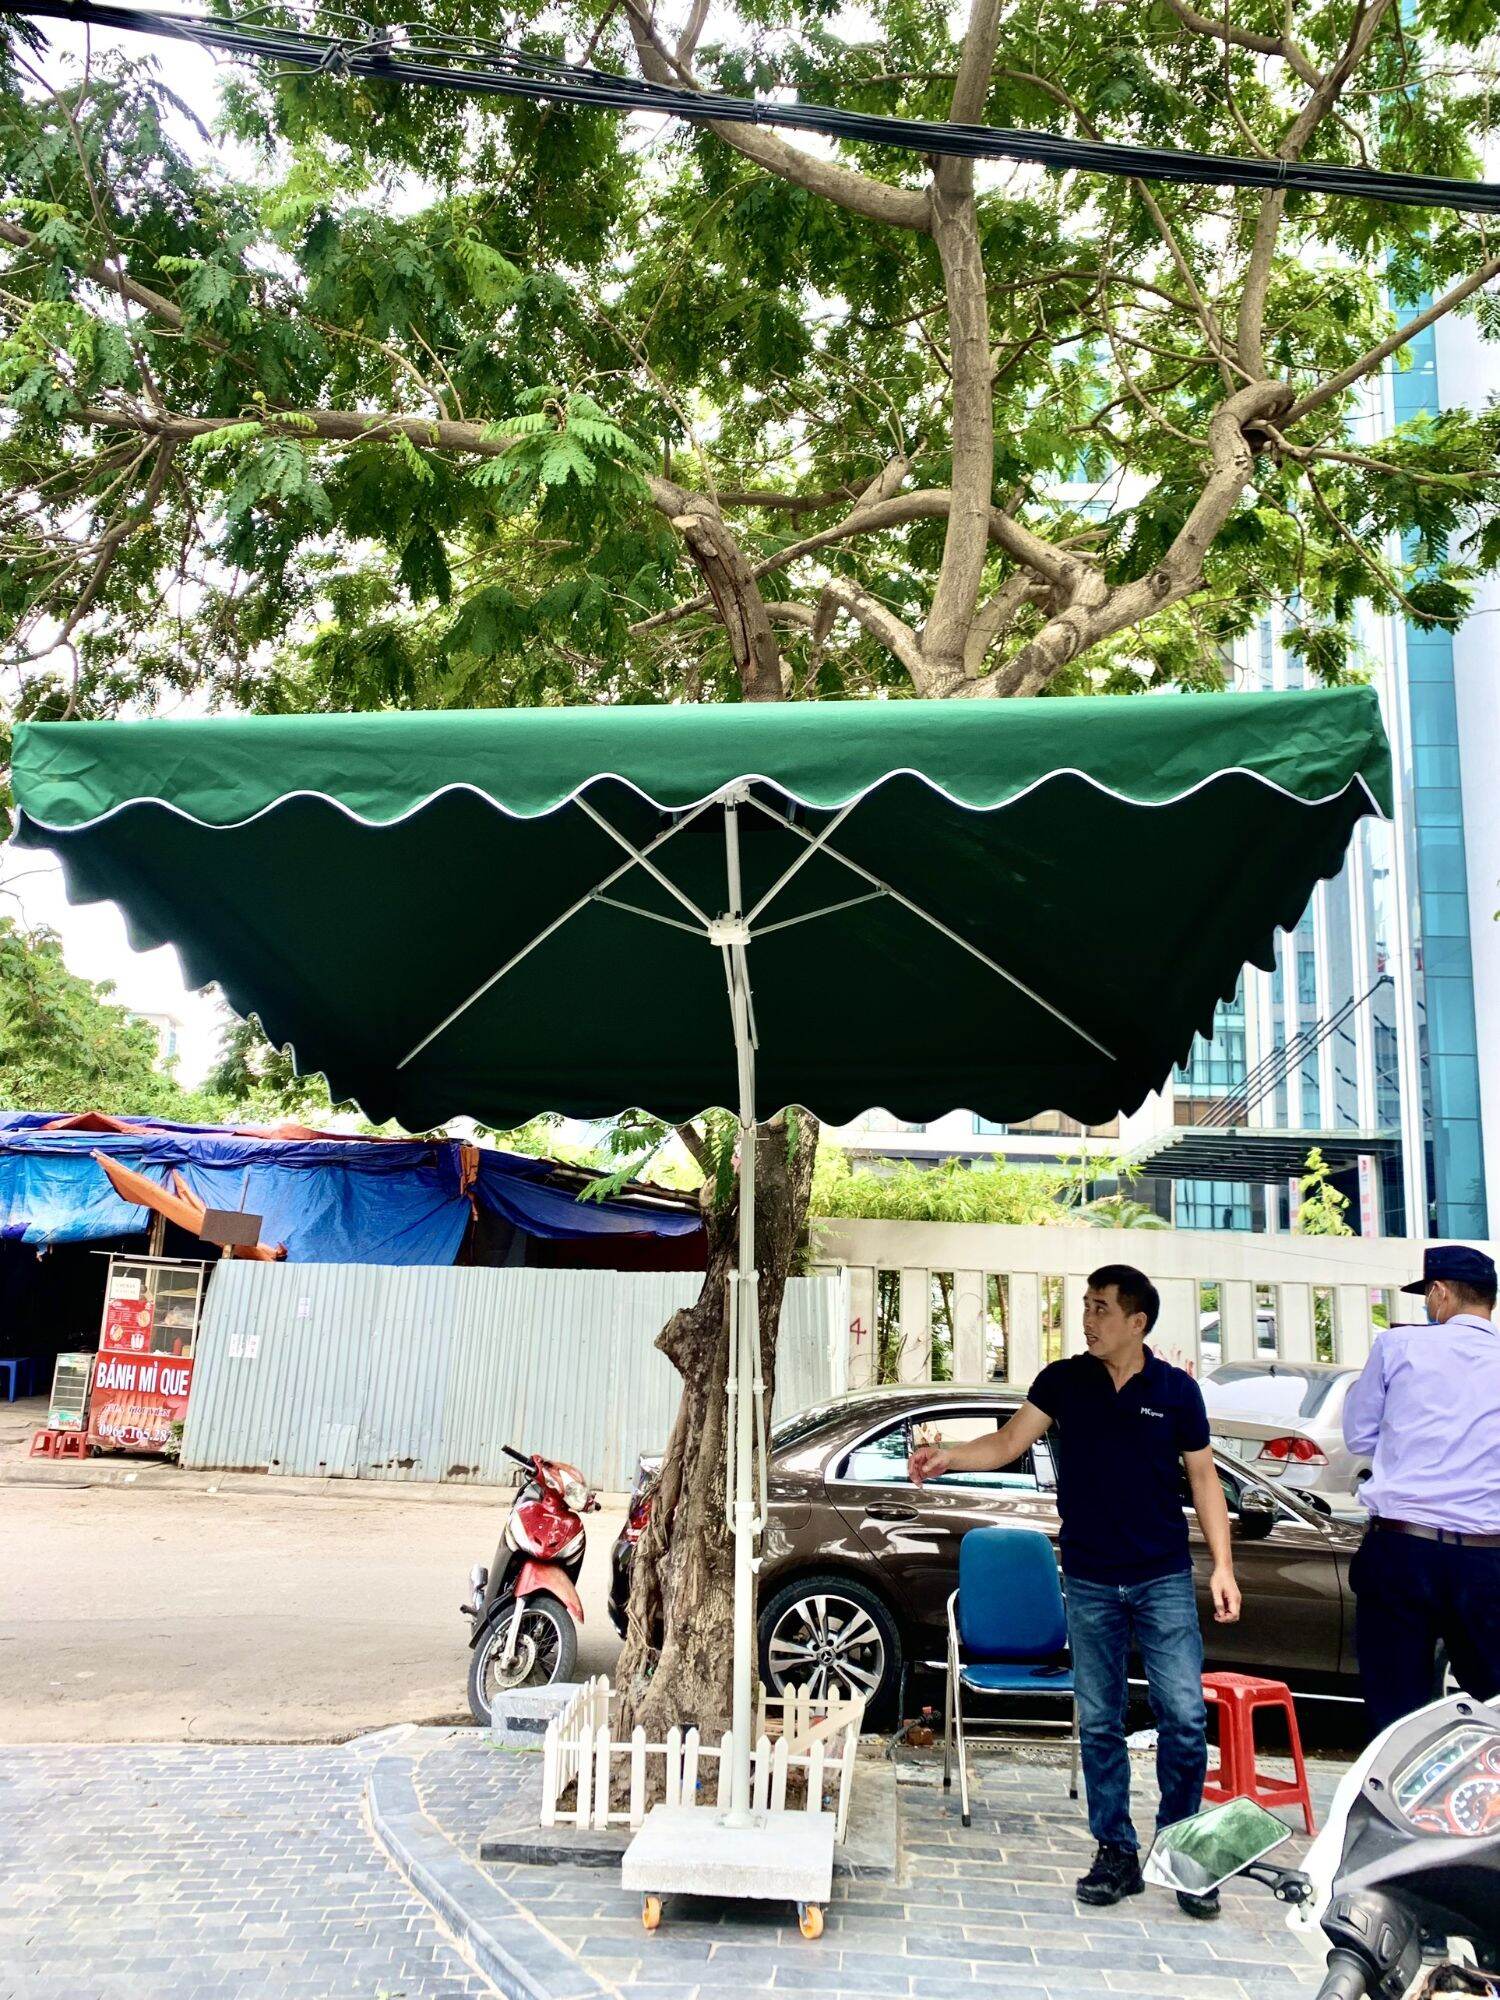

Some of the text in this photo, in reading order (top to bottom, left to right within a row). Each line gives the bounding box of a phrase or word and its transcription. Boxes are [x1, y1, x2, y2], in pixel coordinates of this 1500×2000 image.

[850, 1317, 867, 1345] 4
[96, 1357, 190, 1396] BÁNH MÌ QUE
